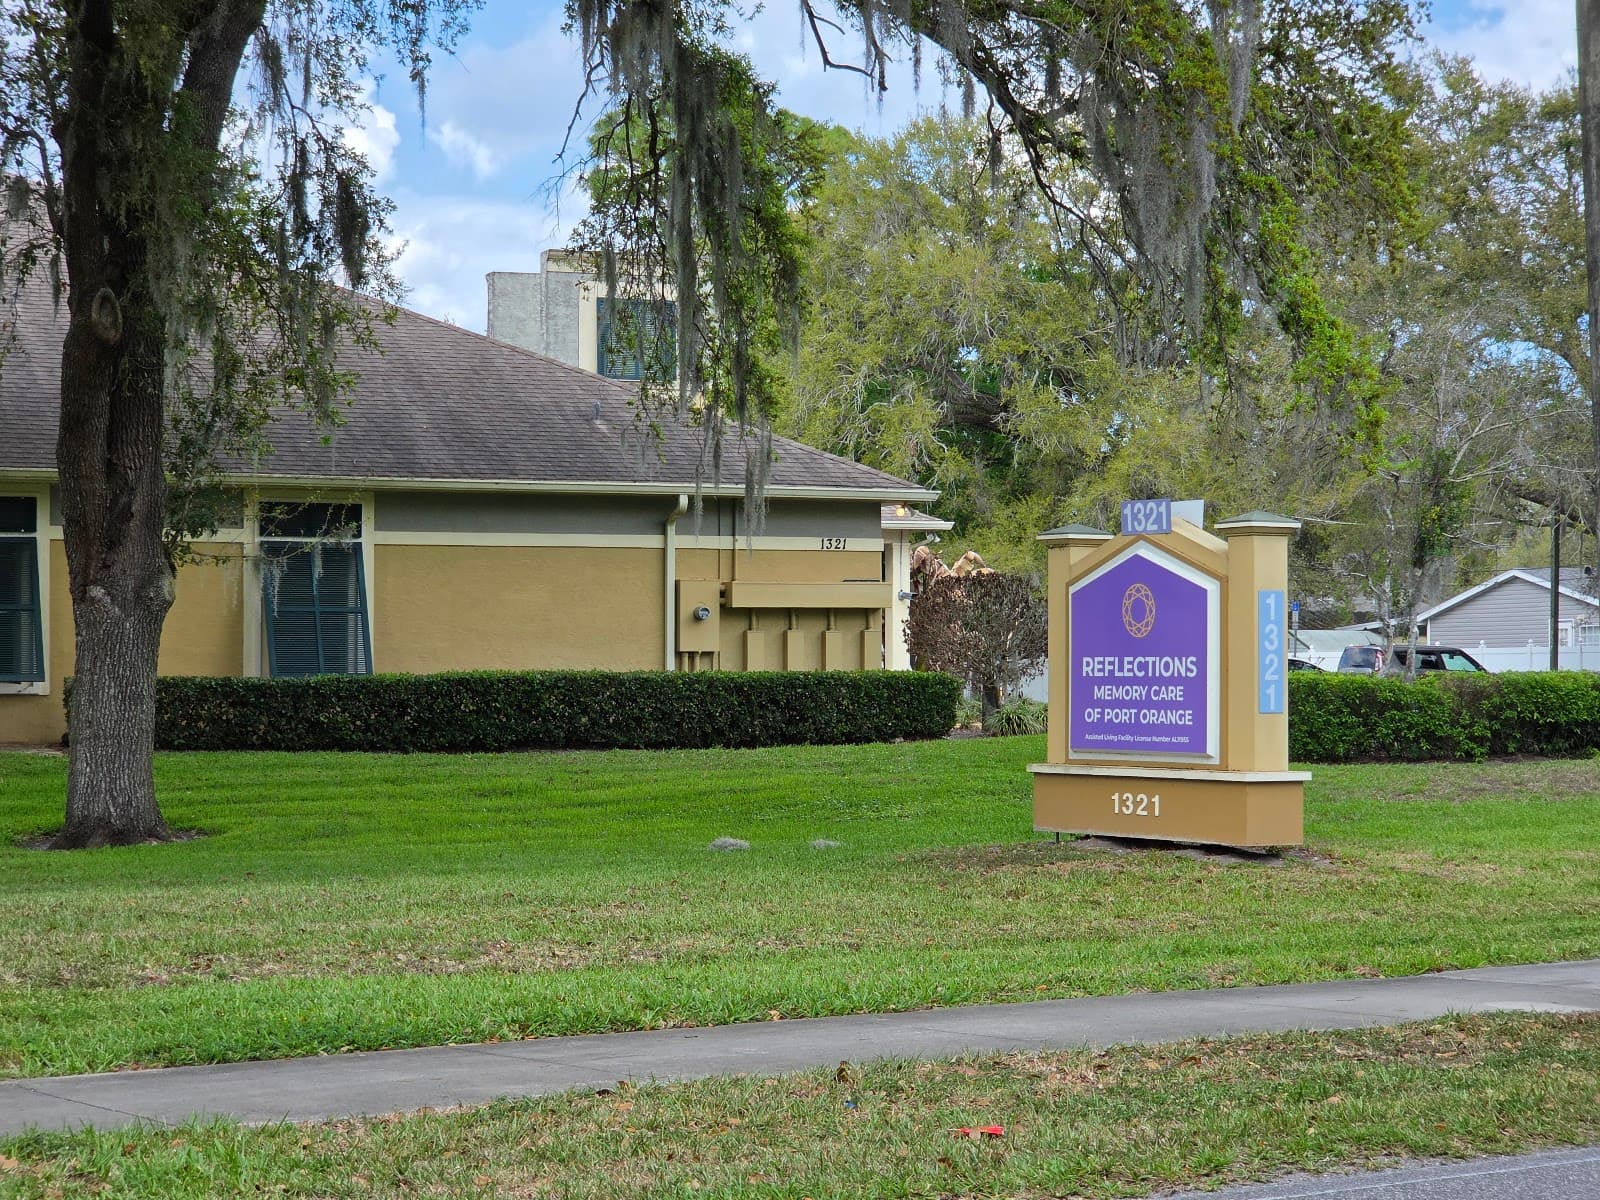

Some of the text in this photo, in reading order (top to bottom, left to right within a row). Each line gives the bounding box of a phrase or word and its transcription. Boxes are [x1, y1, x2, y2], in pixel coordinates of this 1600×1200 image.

[1123, 501, 1167, 532] 1321
[820, 538, 847, 550] 1321
[1264, 593, 1280, 711] 1321
[1082, 656, 1197, 678] REFLECTIONS
[1094, 685, 1184, 701] MEMORY CARE
[1084, 708, 1193, 725] OF PORT ORANGE
[1104, 733, 1118, 742] Living
[1111, 792, 1160, 817] 1321
